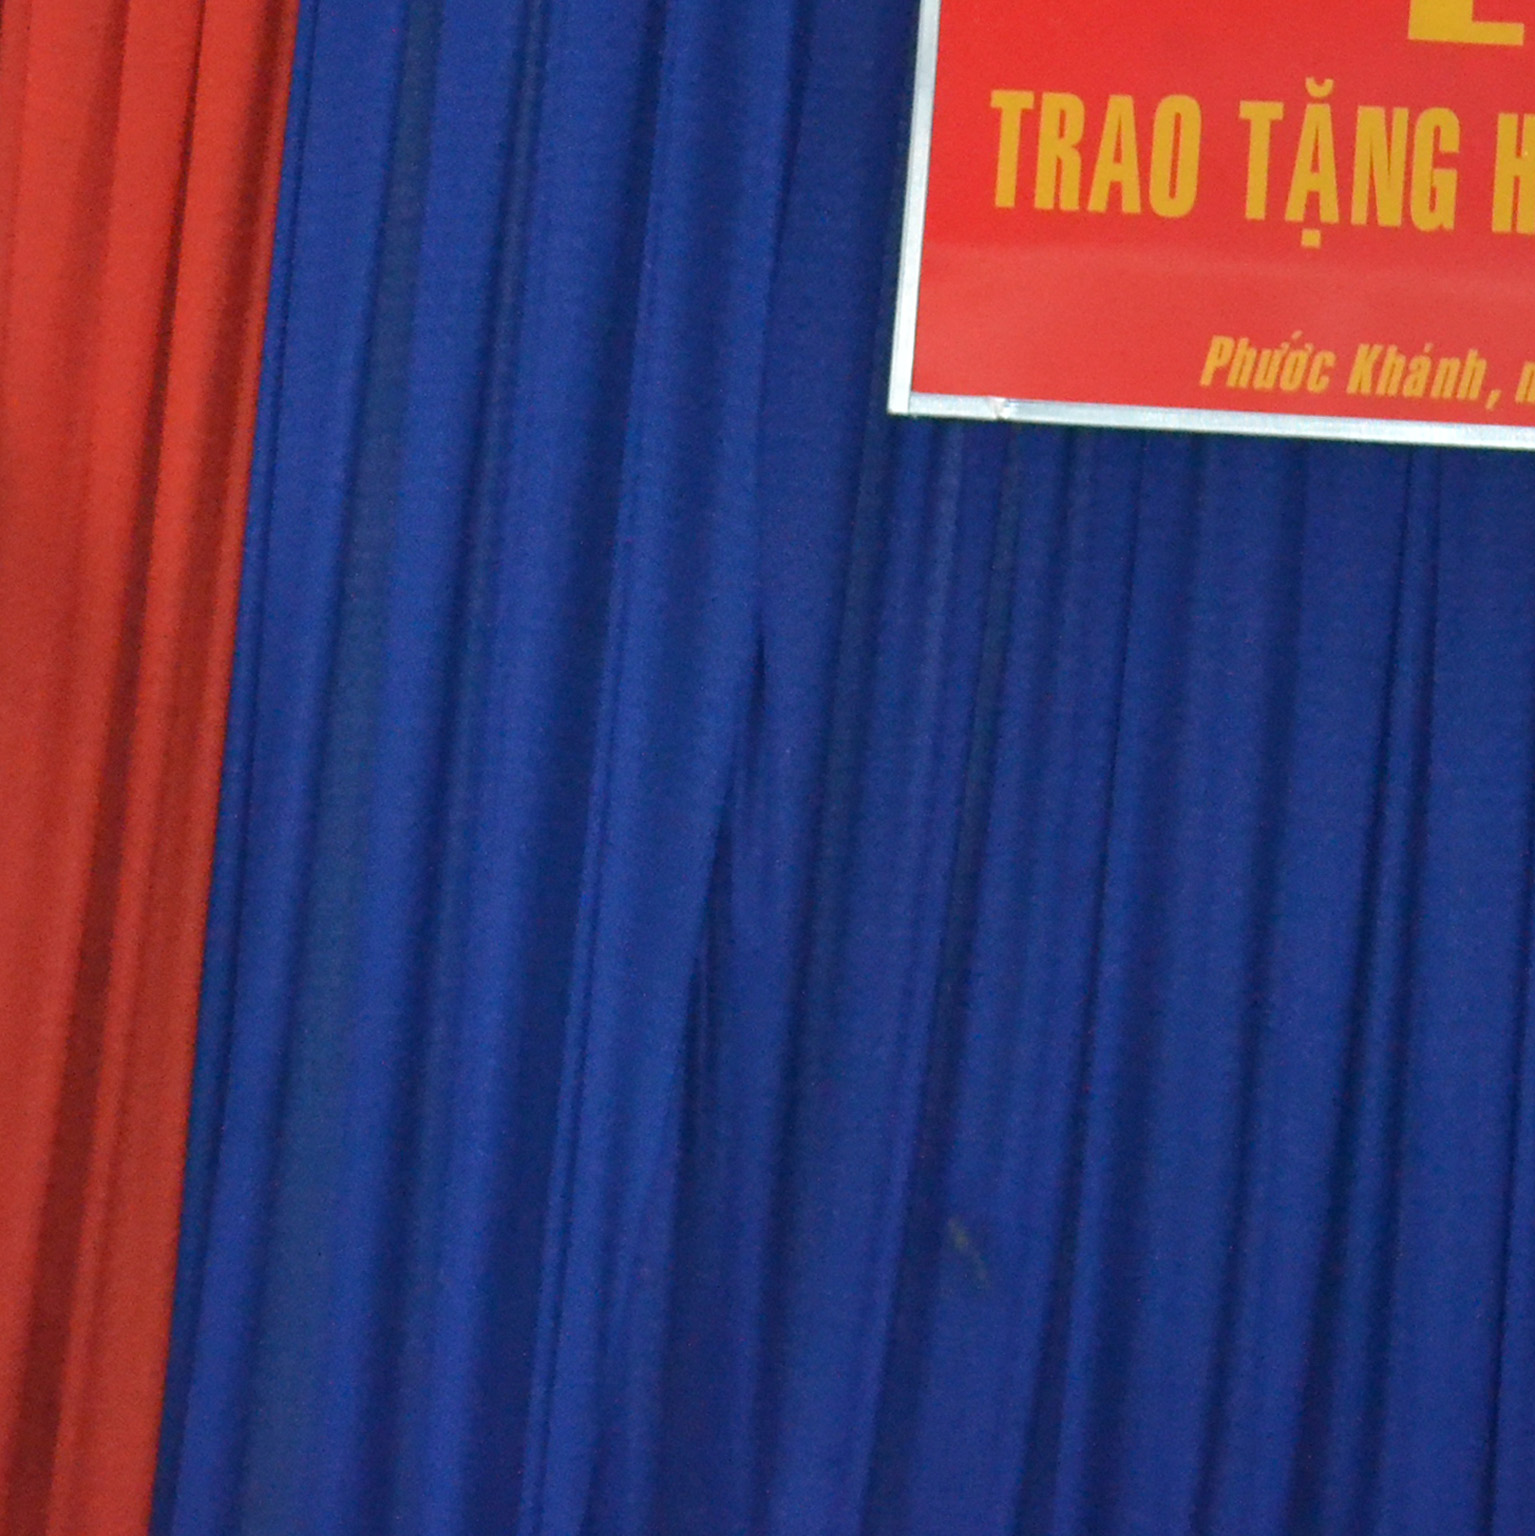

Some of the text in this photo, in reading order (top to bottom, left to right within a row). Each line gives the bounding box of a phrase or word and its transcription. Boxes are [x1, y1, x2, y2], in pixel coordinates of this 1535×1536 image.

[989, 89, 1204, 219] TRAO
[1238, 78, 1462, 249] TẶNG
[1199, 330, 1336, 394] Phước
[1346, 342, 1503, 410] Khánh,
